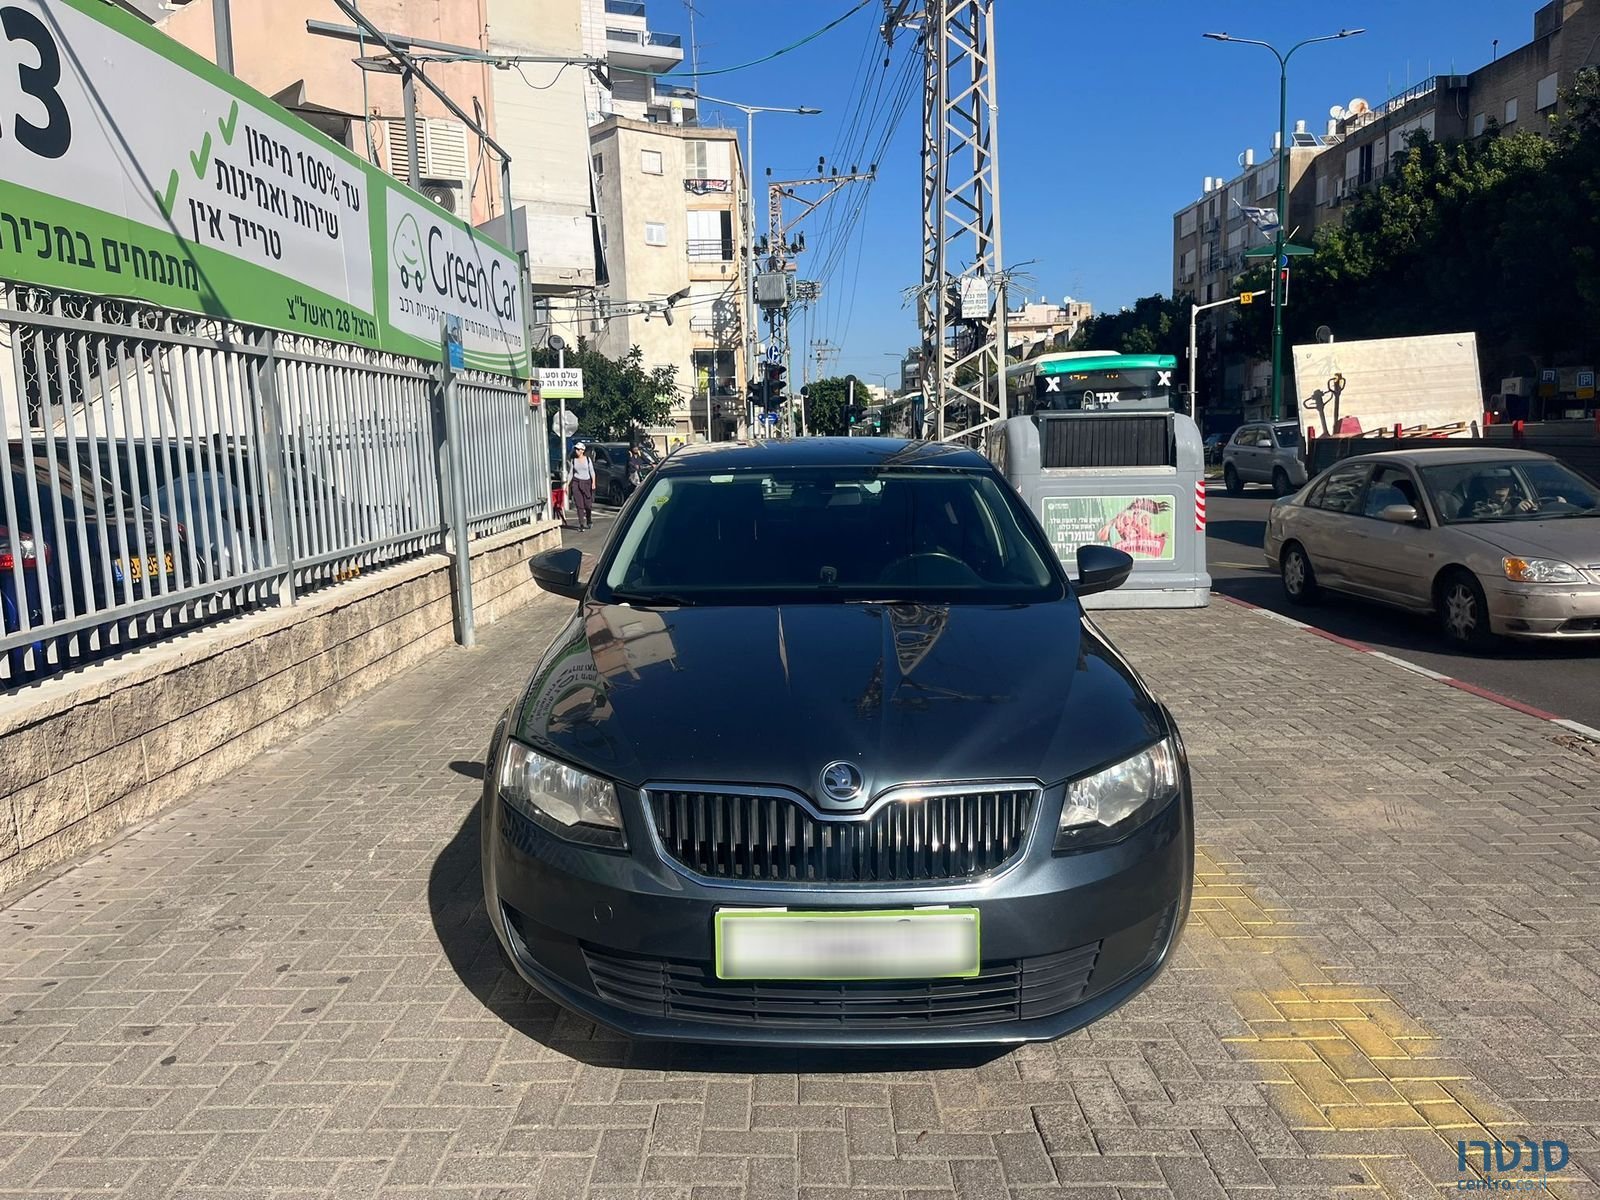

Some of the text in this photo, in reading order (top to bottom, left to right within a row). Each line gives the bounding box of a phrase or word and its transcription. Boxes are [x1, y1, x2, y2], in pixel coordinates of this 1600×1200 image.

[0, 6, 71, 158] 3
[245, 125, 360, 212] עד 100% מימון
[214, 157, 339, 240] שירות ואמינות
[188, 197, 282, 260] טרייד אין
[0, 212, 200, 292] מתמחים במכיר
[399, 296, 414, 315] רכב
[416, 302, 439, 325] לקניית
[335, 307, 350, 334] 28
[351, 311, 377, 340] הרצל
[557, 379, 579, 387] אצלנו
[560, 371, 578, 379] שלם
[1095, 391, 1119, 404] אגד
[1057, 531, 1096, 541] שומרים
